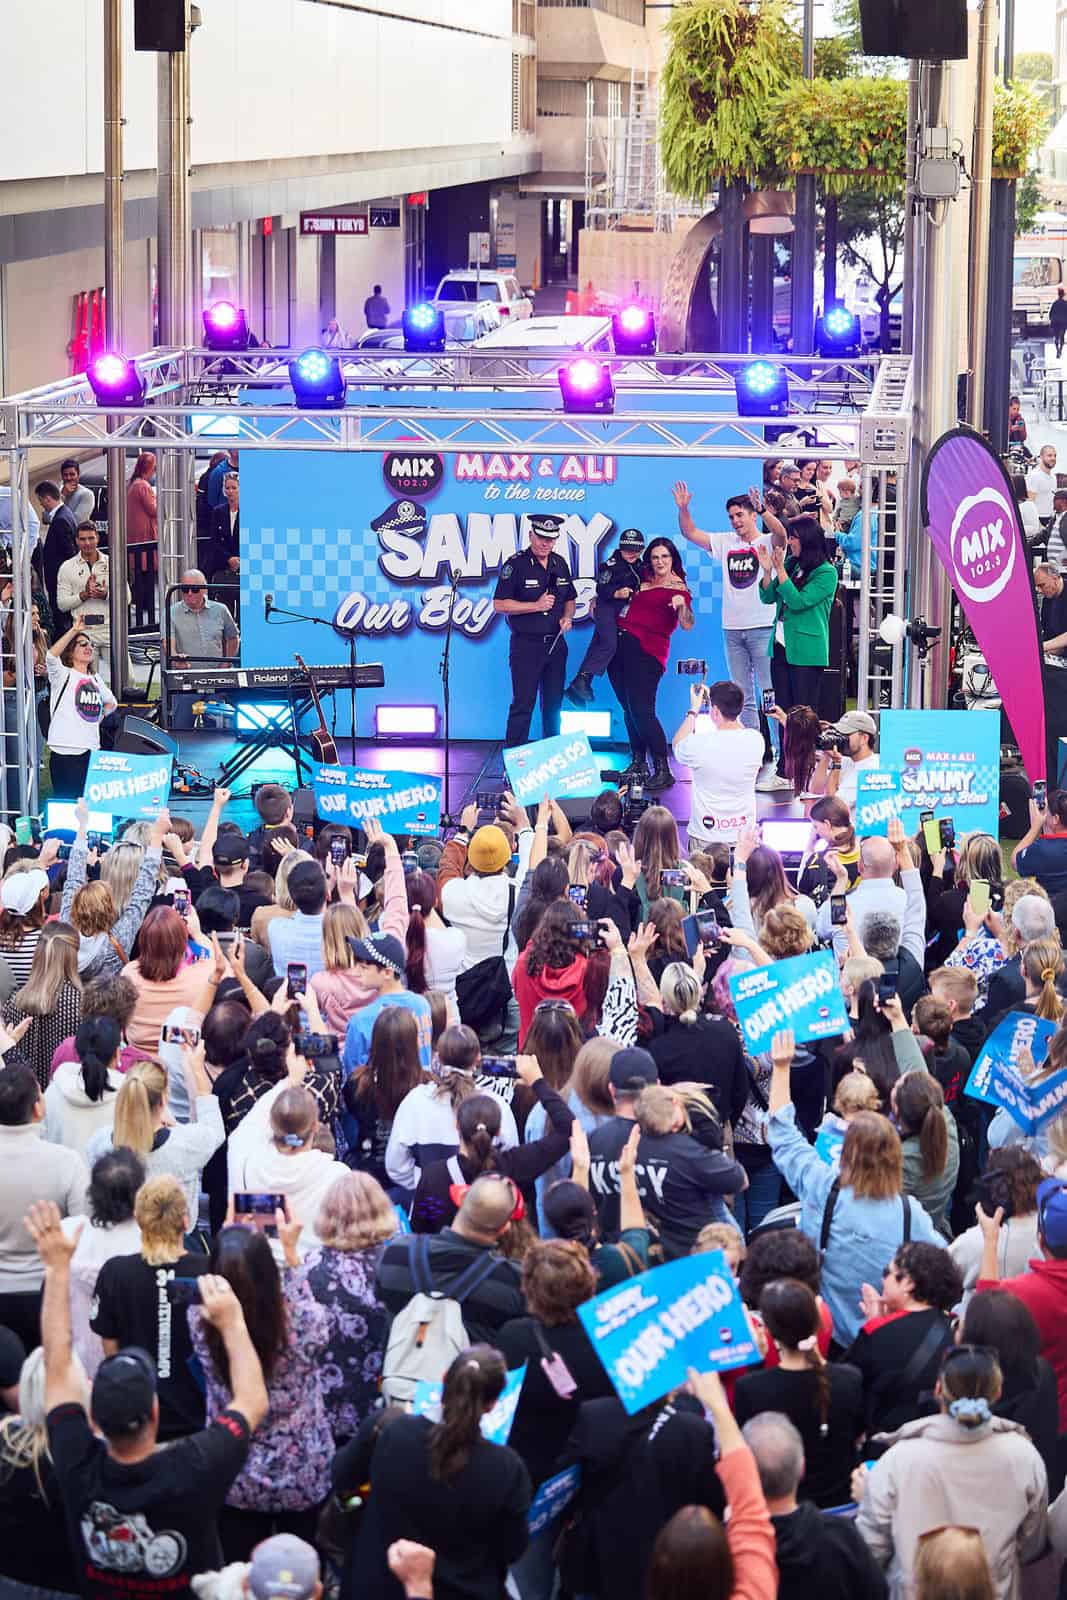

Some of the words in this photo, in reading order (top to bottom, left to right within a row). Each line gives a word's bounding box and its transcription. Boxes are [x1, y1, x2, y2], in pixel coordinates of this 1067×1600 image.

[391, 458, 435, 477] MIX
[457, 454, 531, 479] MAX
[538, 459, 553, 476] &
[561, 455, 614, 480] ALI
[484, 484, 500, 500] to
[505, 483, 530, 500] the
[533, 486, 585, 500] rescue
[378, 512, 614, 579] SAMY
[961, 518, 1006, 566] MIX
[730, 558, 754, 570] MIX
[971, 555, 1001, 578] 102.3
[335, 591, 411, 633] Our
[419, 586, 496, 635] Boy
[254, 674, 288, 682] Roland
[959, 752, 976, 760] ALI
[88, 780, 129, 804] OUR
[128, 768, 168, 797] HERO
[903, 770, 975, 792] SAMMY
[350, 797, 389, 818] OUR
[387, 784, 437, 813] HERO
[717, 816, 747, 829] 102.3
[744, 999, 784, 1041] OUR
[776, 967, 834, 1017] HERO
[615, 1322, 676, 1386] OUR
[659, 1274, 733, 1340] HERO
